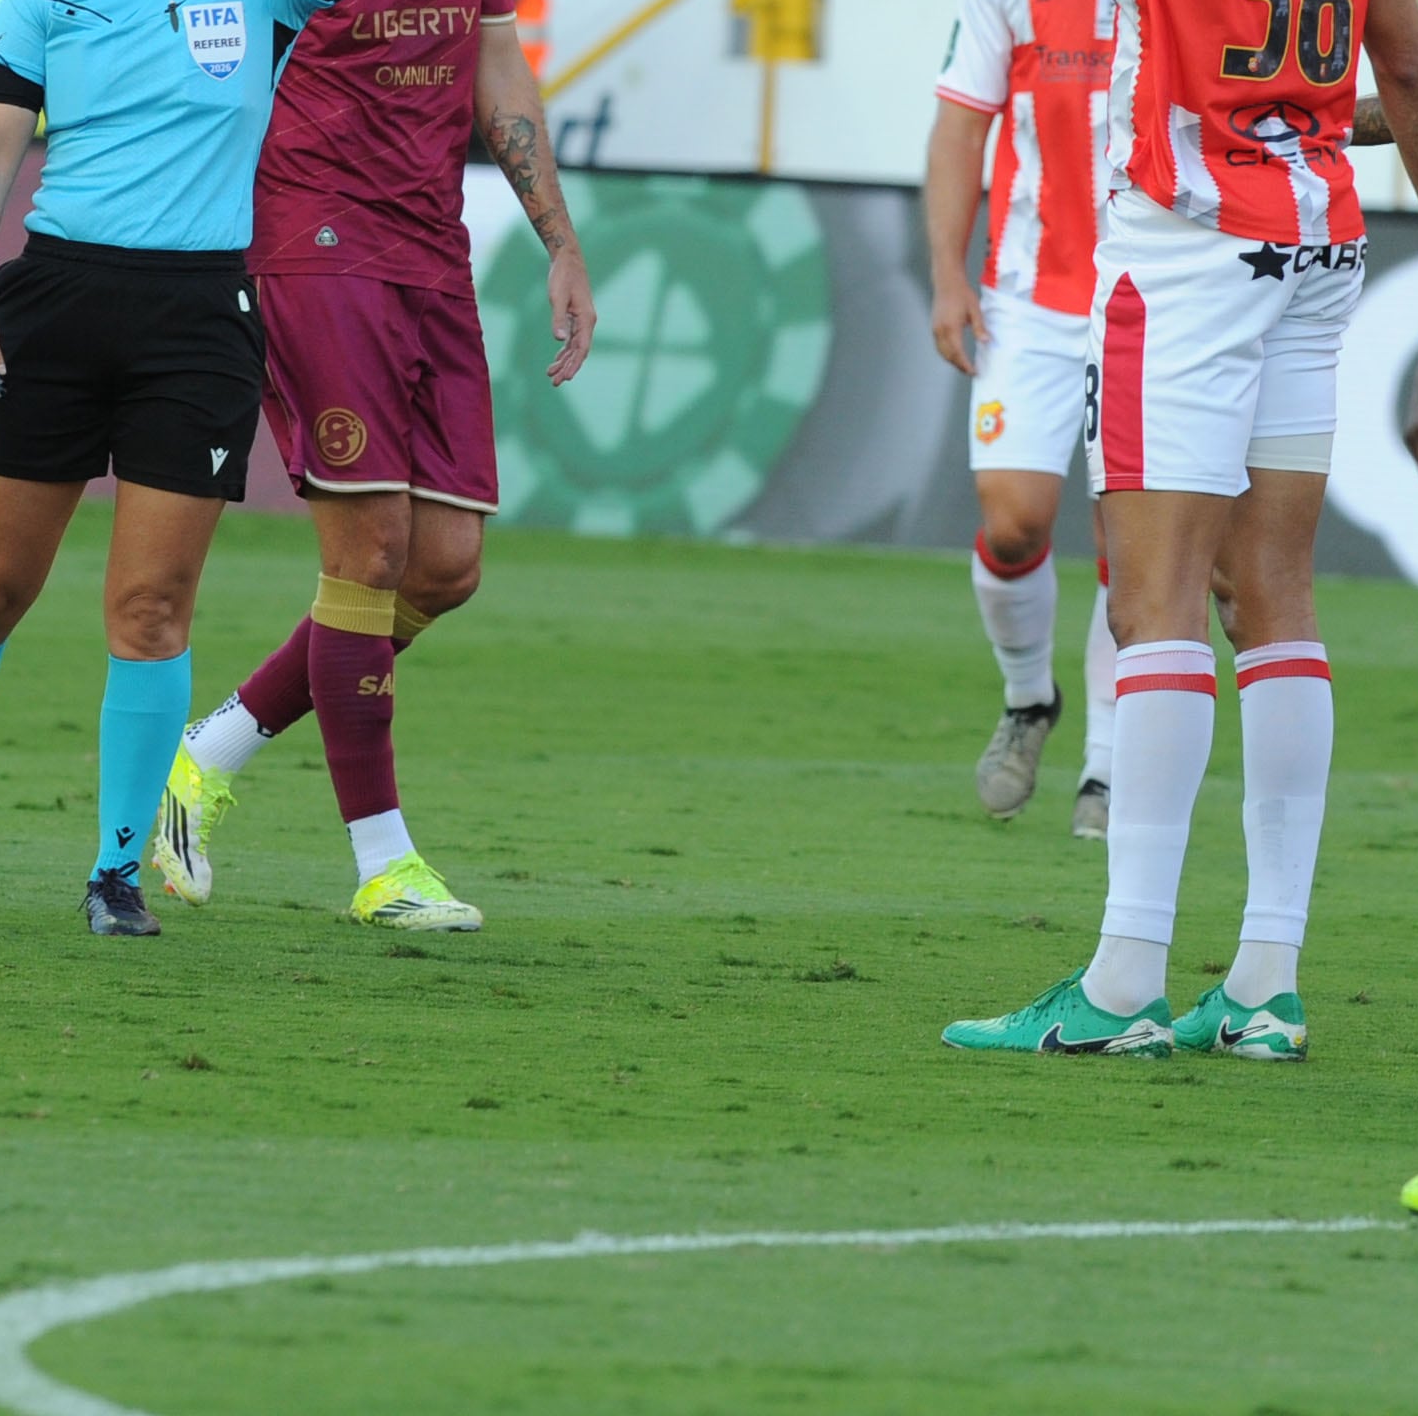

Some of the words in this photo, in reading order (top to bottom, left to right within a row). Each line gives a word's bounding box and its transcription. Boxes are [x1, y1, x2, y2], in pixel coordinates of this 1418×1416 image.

[189, 7, 239, 27] FIFA
[351, 7, 477, 40] LIBERTY
[194, 37, 242, 50] REFEREE
[209, 62, 233, 74] 2026
[375, 65, 456, 86] OMNILIFE
